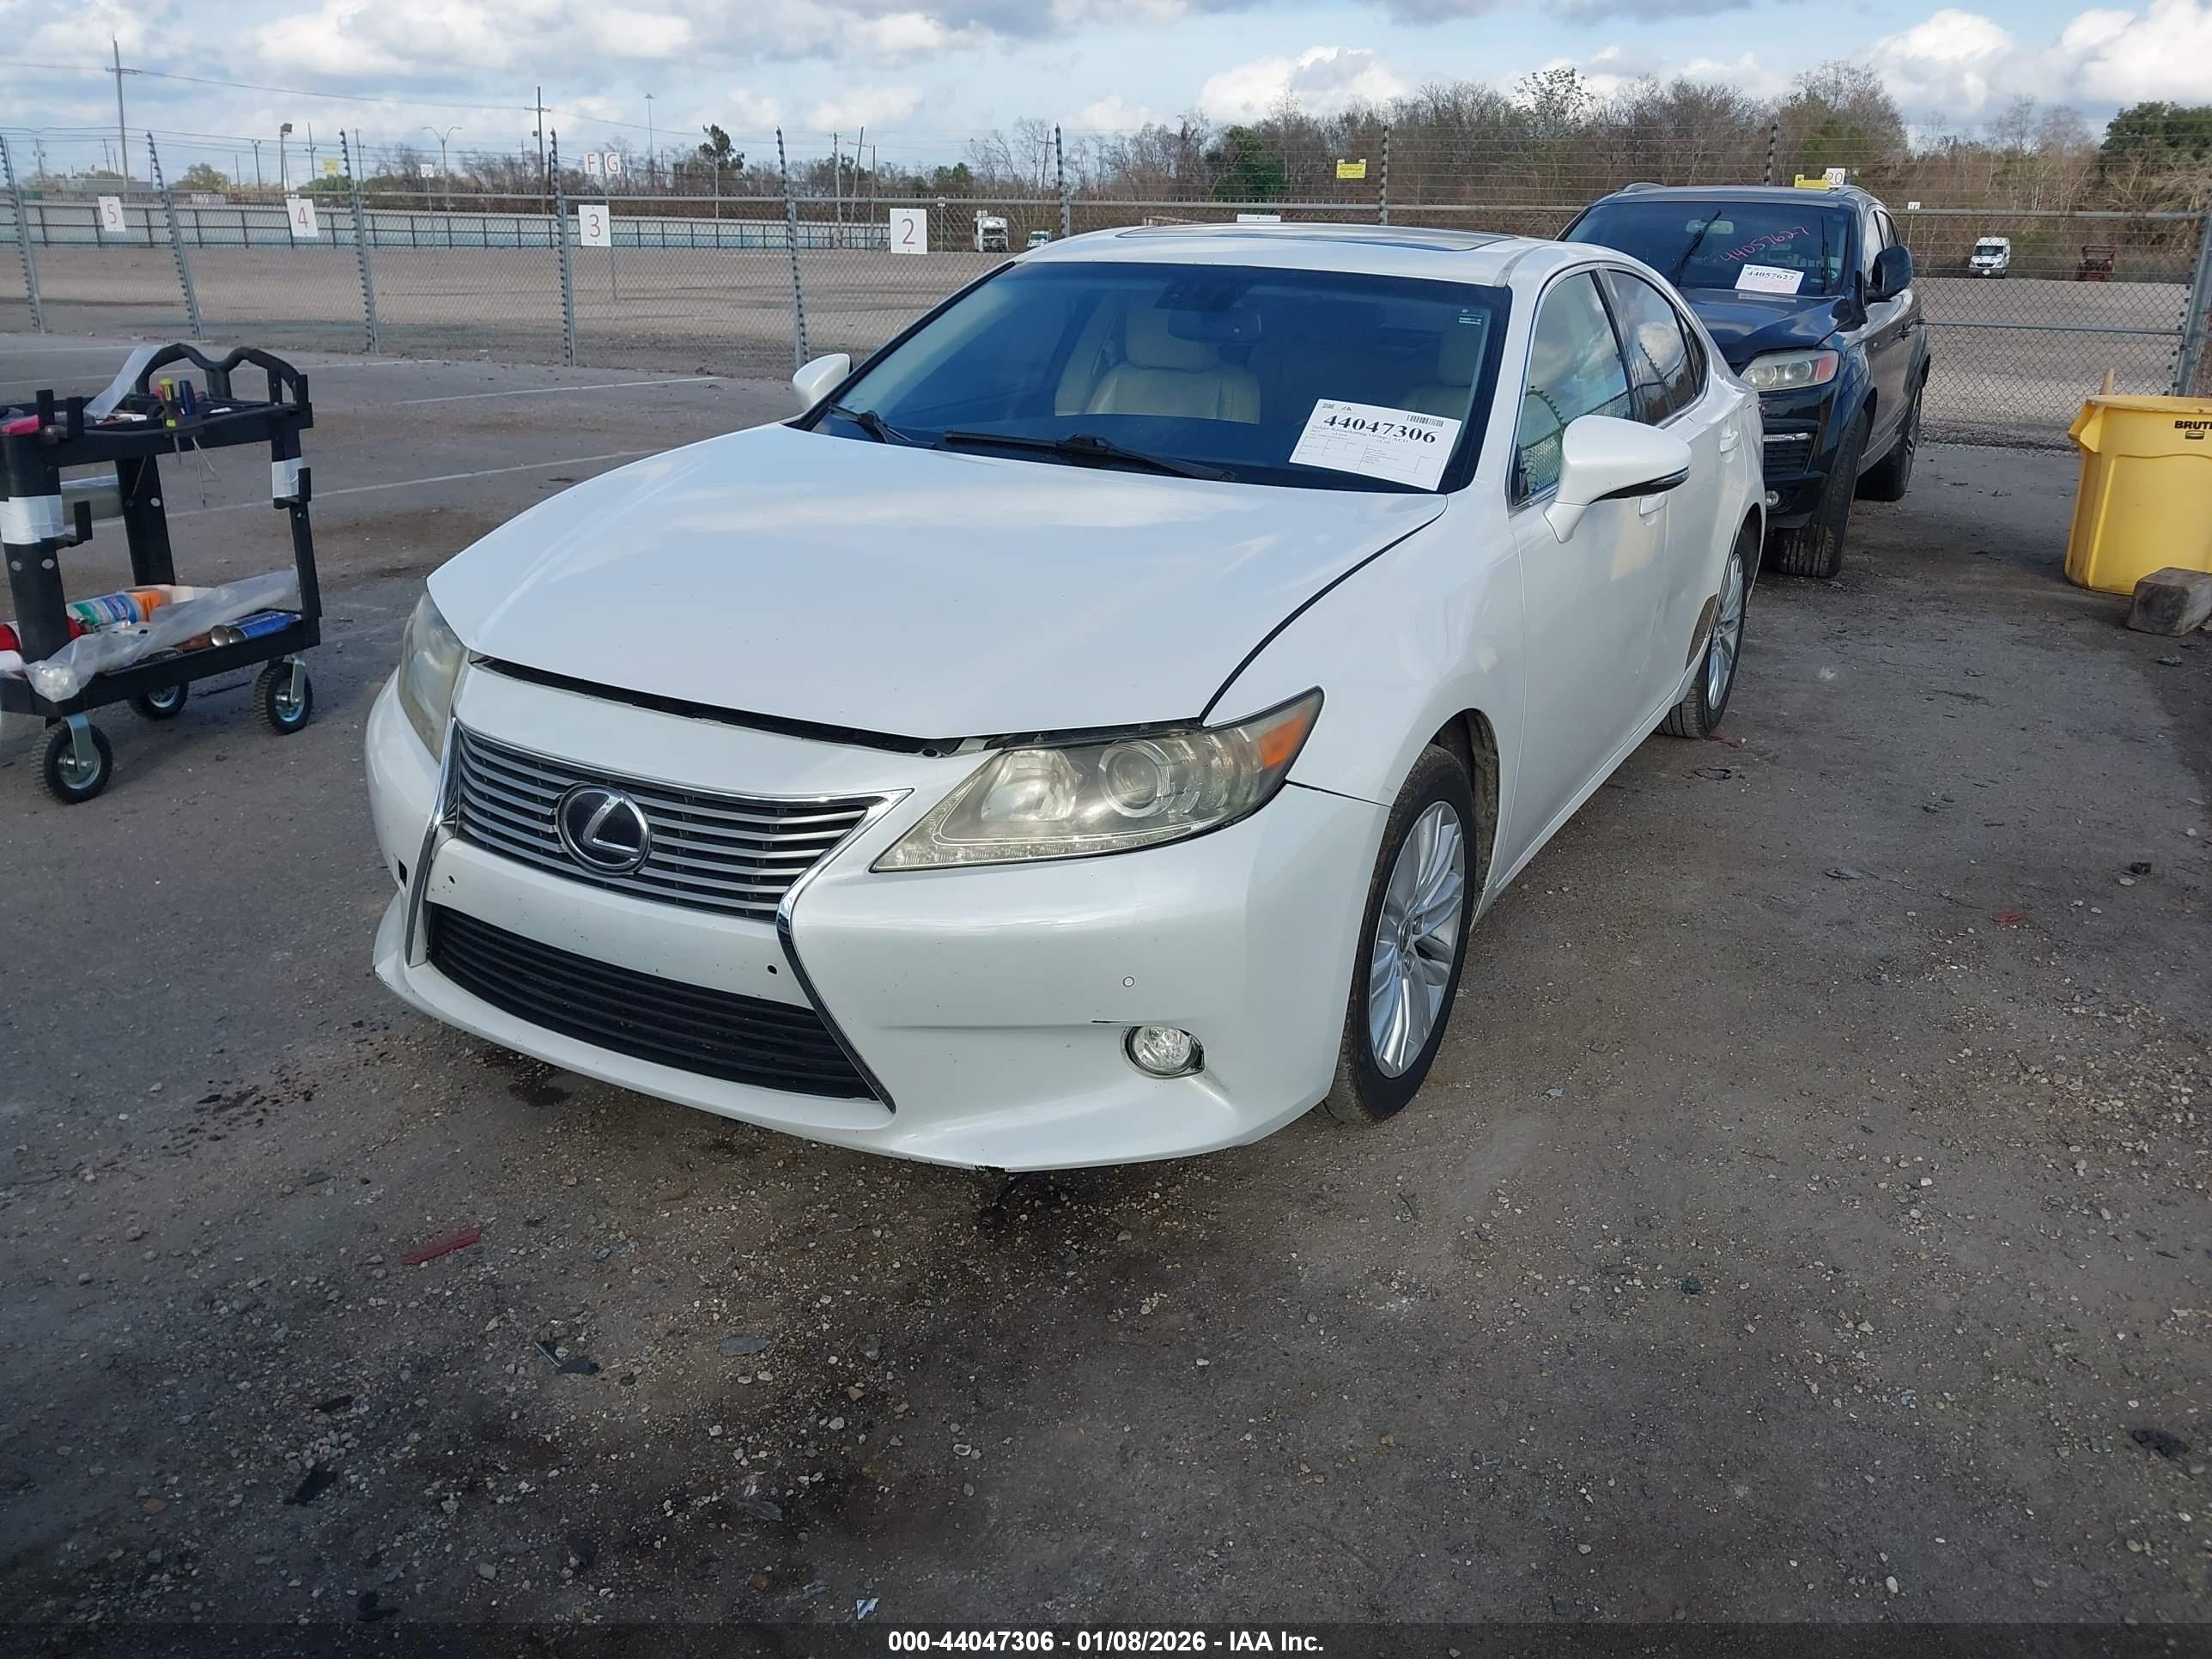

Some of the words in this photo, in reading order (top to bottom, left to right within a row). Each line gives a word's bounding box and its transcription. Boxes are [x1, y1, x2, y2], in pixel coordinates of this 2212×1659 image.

[586, 153, 596, 173] F
[606, 153, 619, 173] G
[1827, 172, 1844, 185] 20
[106, 203, 117, 224] 5
[297, 206, 309, 229] 4
[588, 213, 601, 238] 3
[901, 217, 916, 245] 2
[1719, 225, 1810, 262] 44057627
[1323, 414, 1439, 445] 44047306
